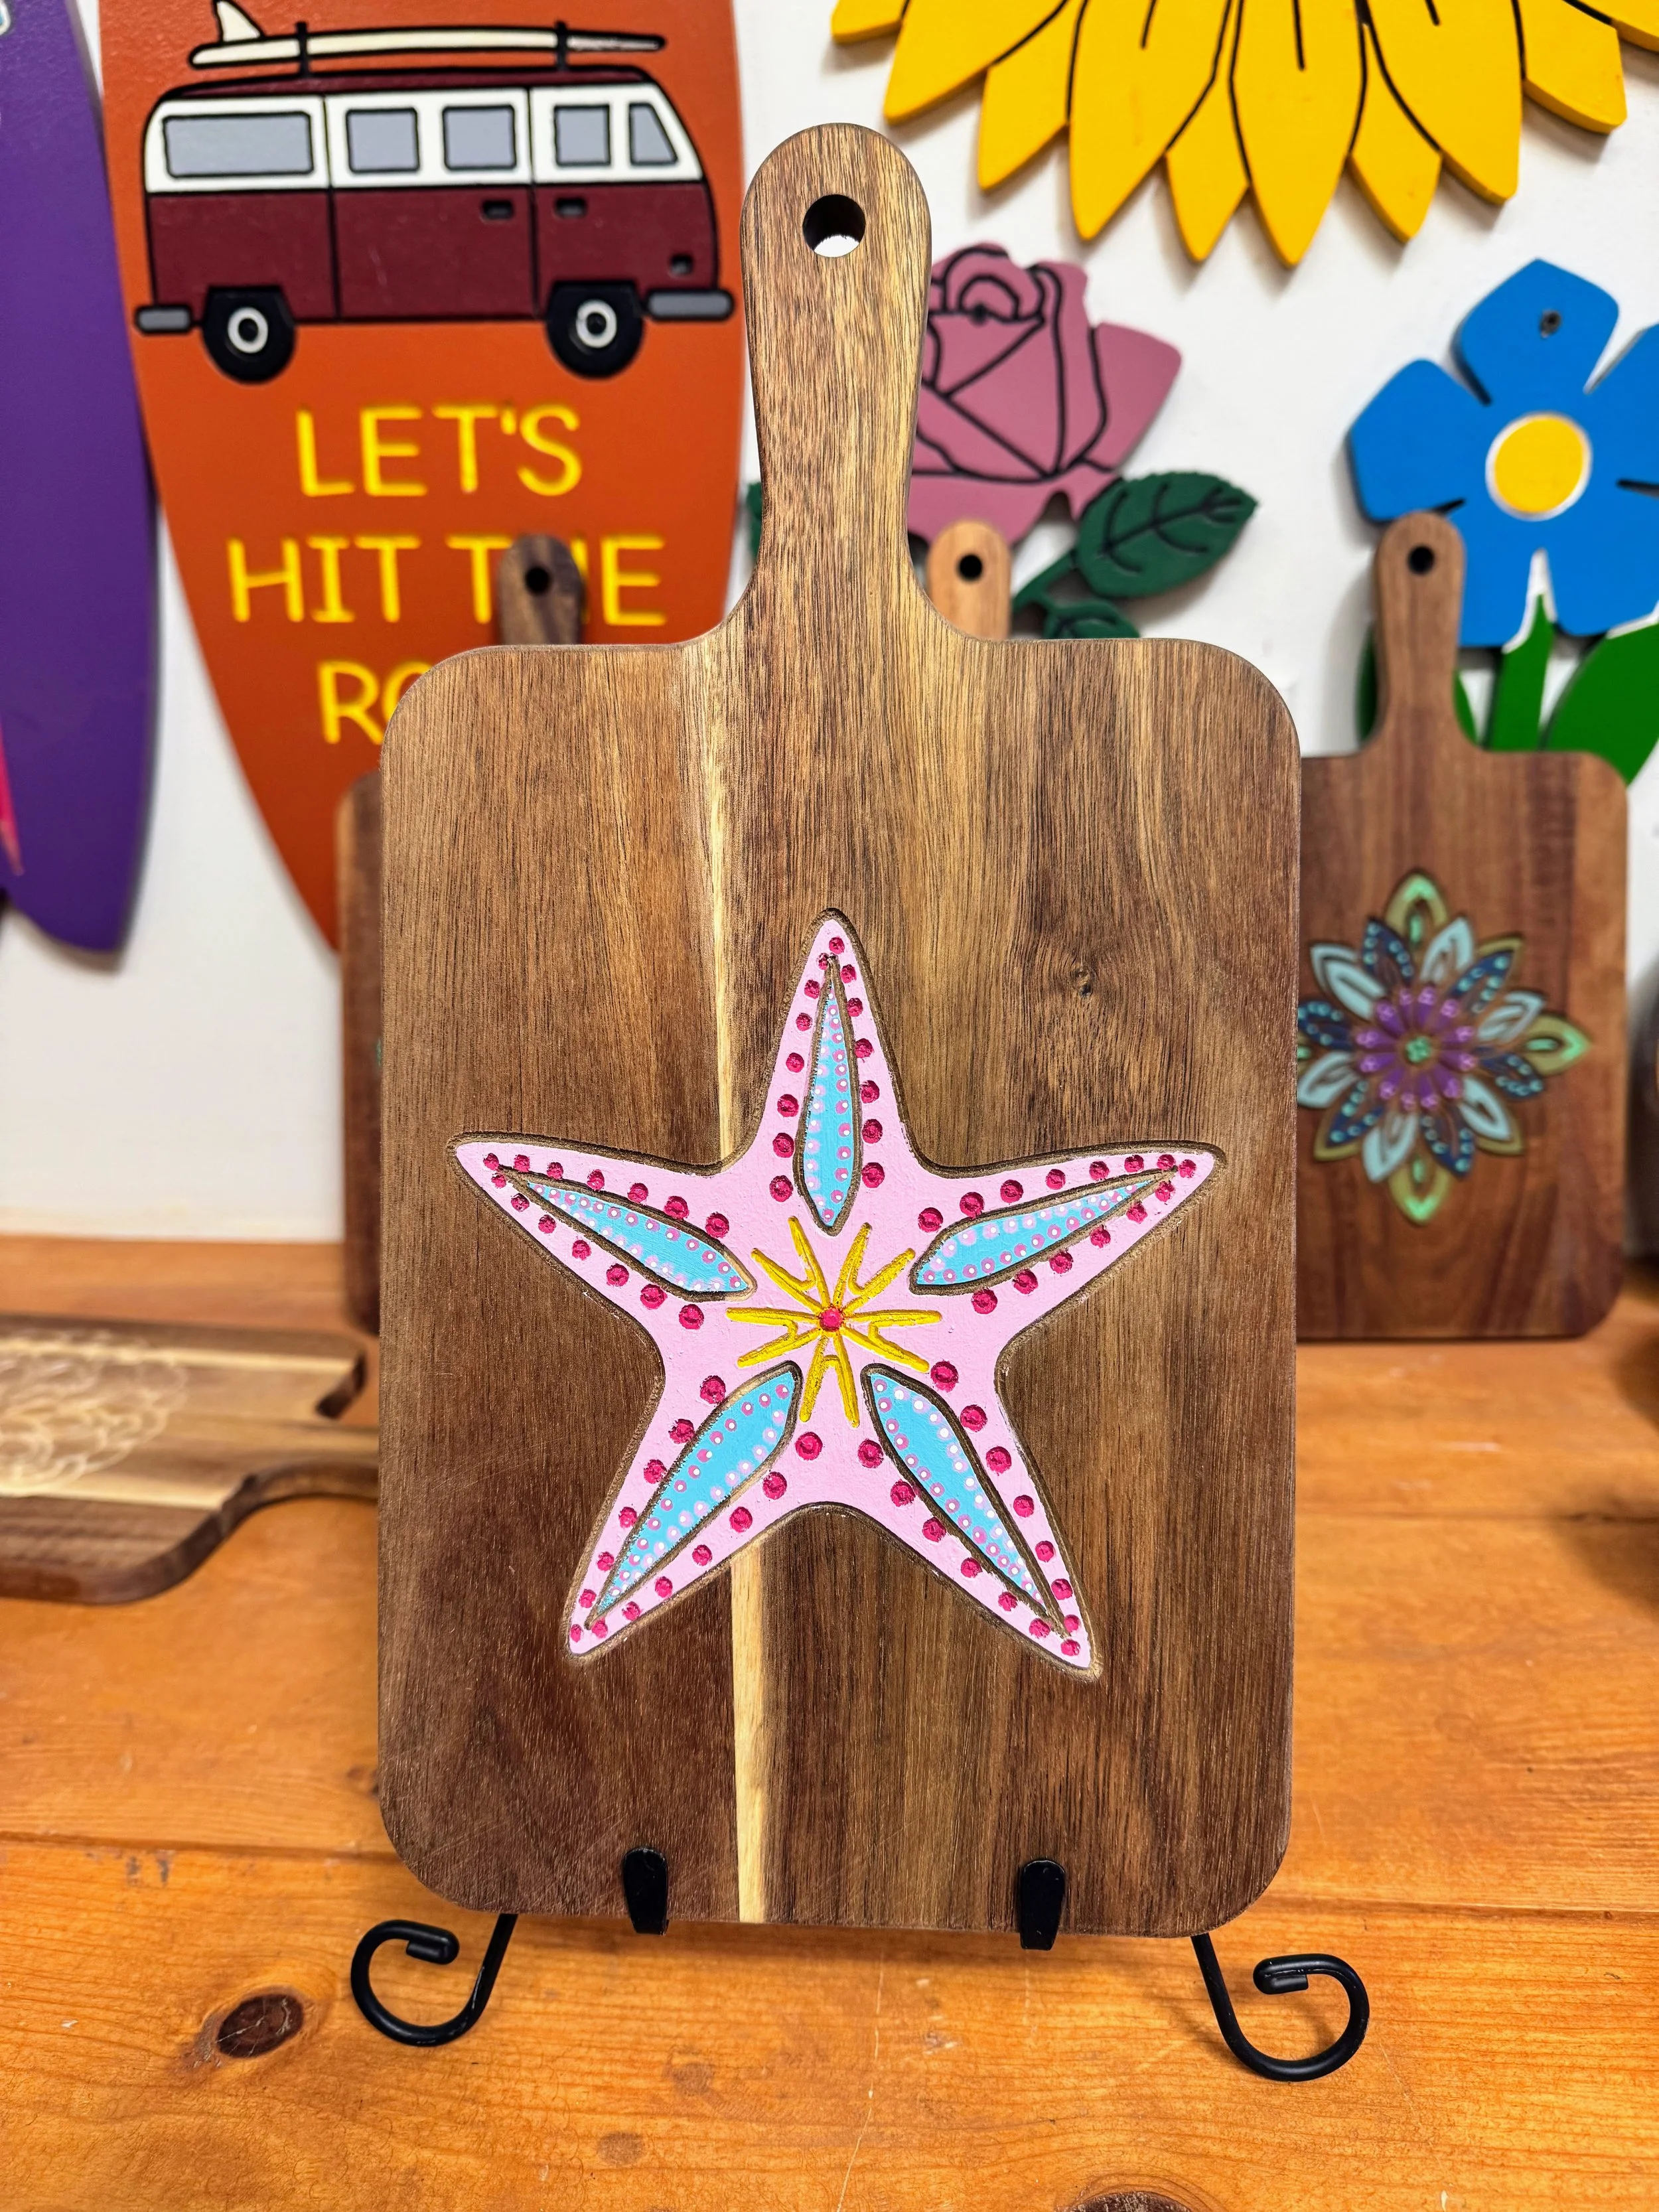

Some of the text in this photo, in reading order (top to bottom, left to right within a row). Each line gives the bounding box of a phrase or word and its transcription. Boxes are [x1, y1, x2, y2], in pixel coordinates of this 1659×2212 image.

[296, 402, 583, 496] LET'S
[227, 534, 666, 626] HIT TE
